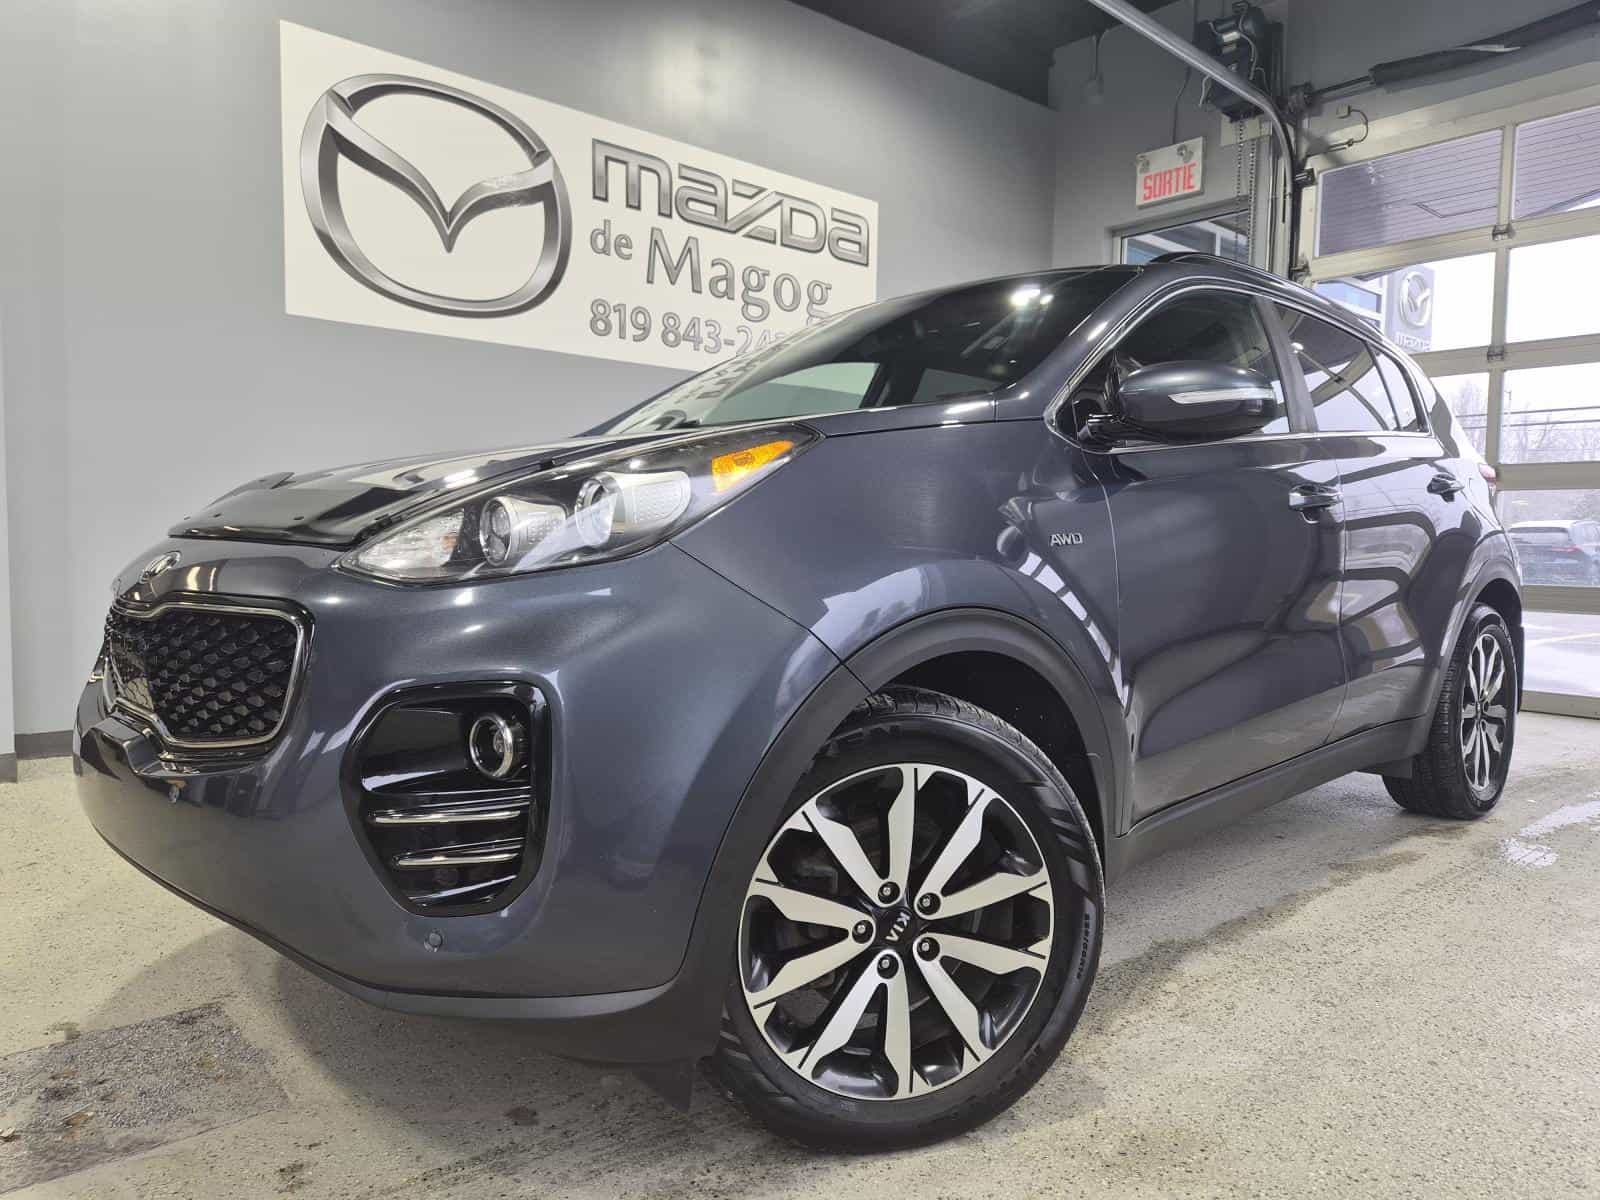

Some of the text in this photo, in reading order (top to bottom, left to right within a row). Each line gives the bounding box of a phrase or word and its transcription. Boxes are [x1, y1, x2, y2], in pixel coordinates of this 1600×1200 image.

[1143, 162, 1197, 201] SORTIE
[589, 218, 832, 327] de Magog
[589, 298, 651, 342] 819
[1050, 532, 1083, 547] AWD
[885, 911, 911, 941] KIA
